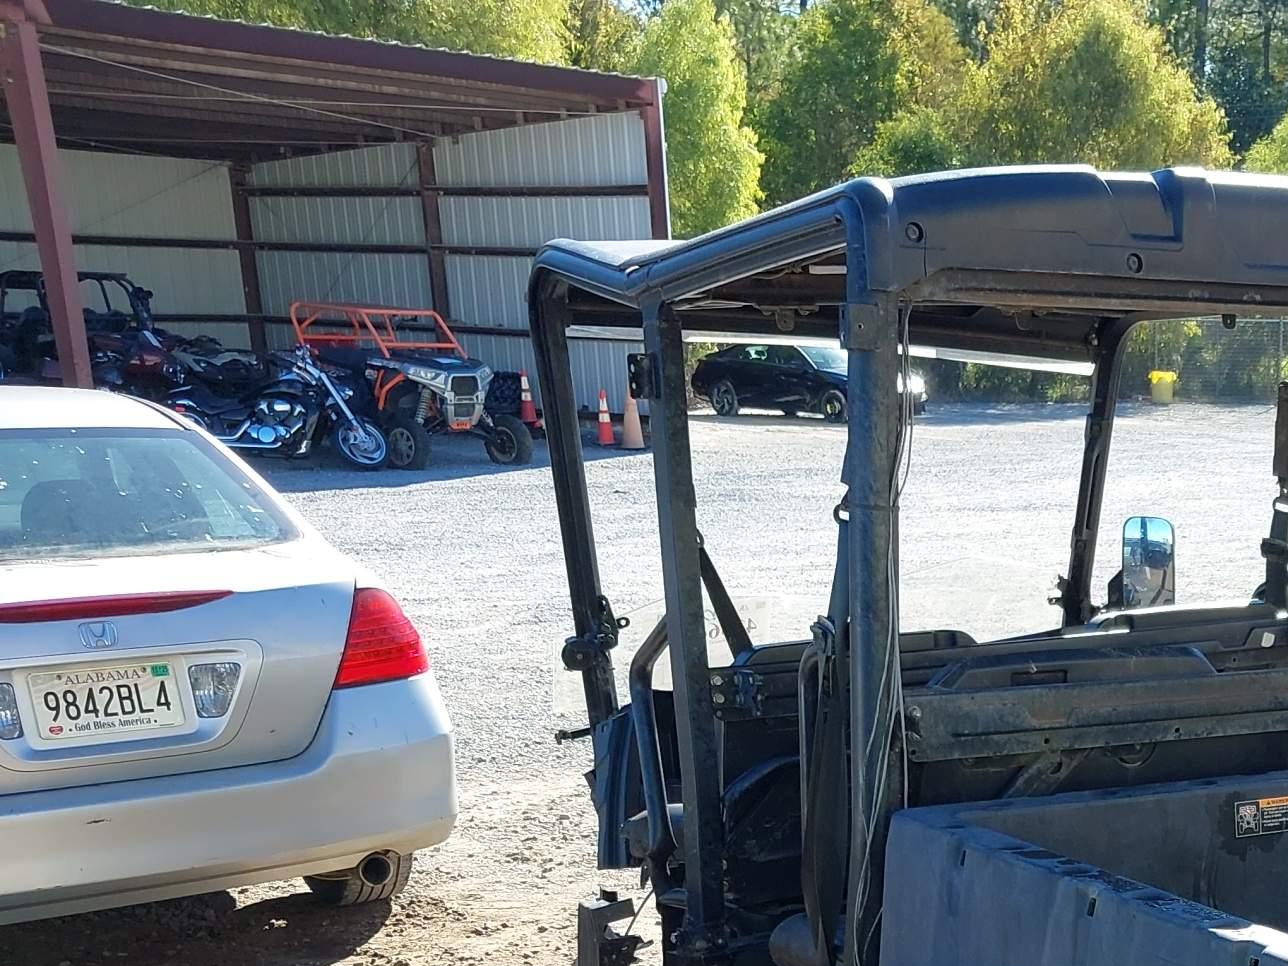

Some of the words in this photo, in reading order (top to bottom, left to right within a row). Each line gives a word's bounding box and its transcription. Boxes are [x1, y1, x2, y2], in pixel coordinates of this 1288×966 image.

[64, 669, 141, 685] ALABAMA
[44, 680, 171, 722] 9842BL4
[75, 721, 92, 732] God
[93, 719, 116, 730] Bless
[118, 717, 152, 728] America
